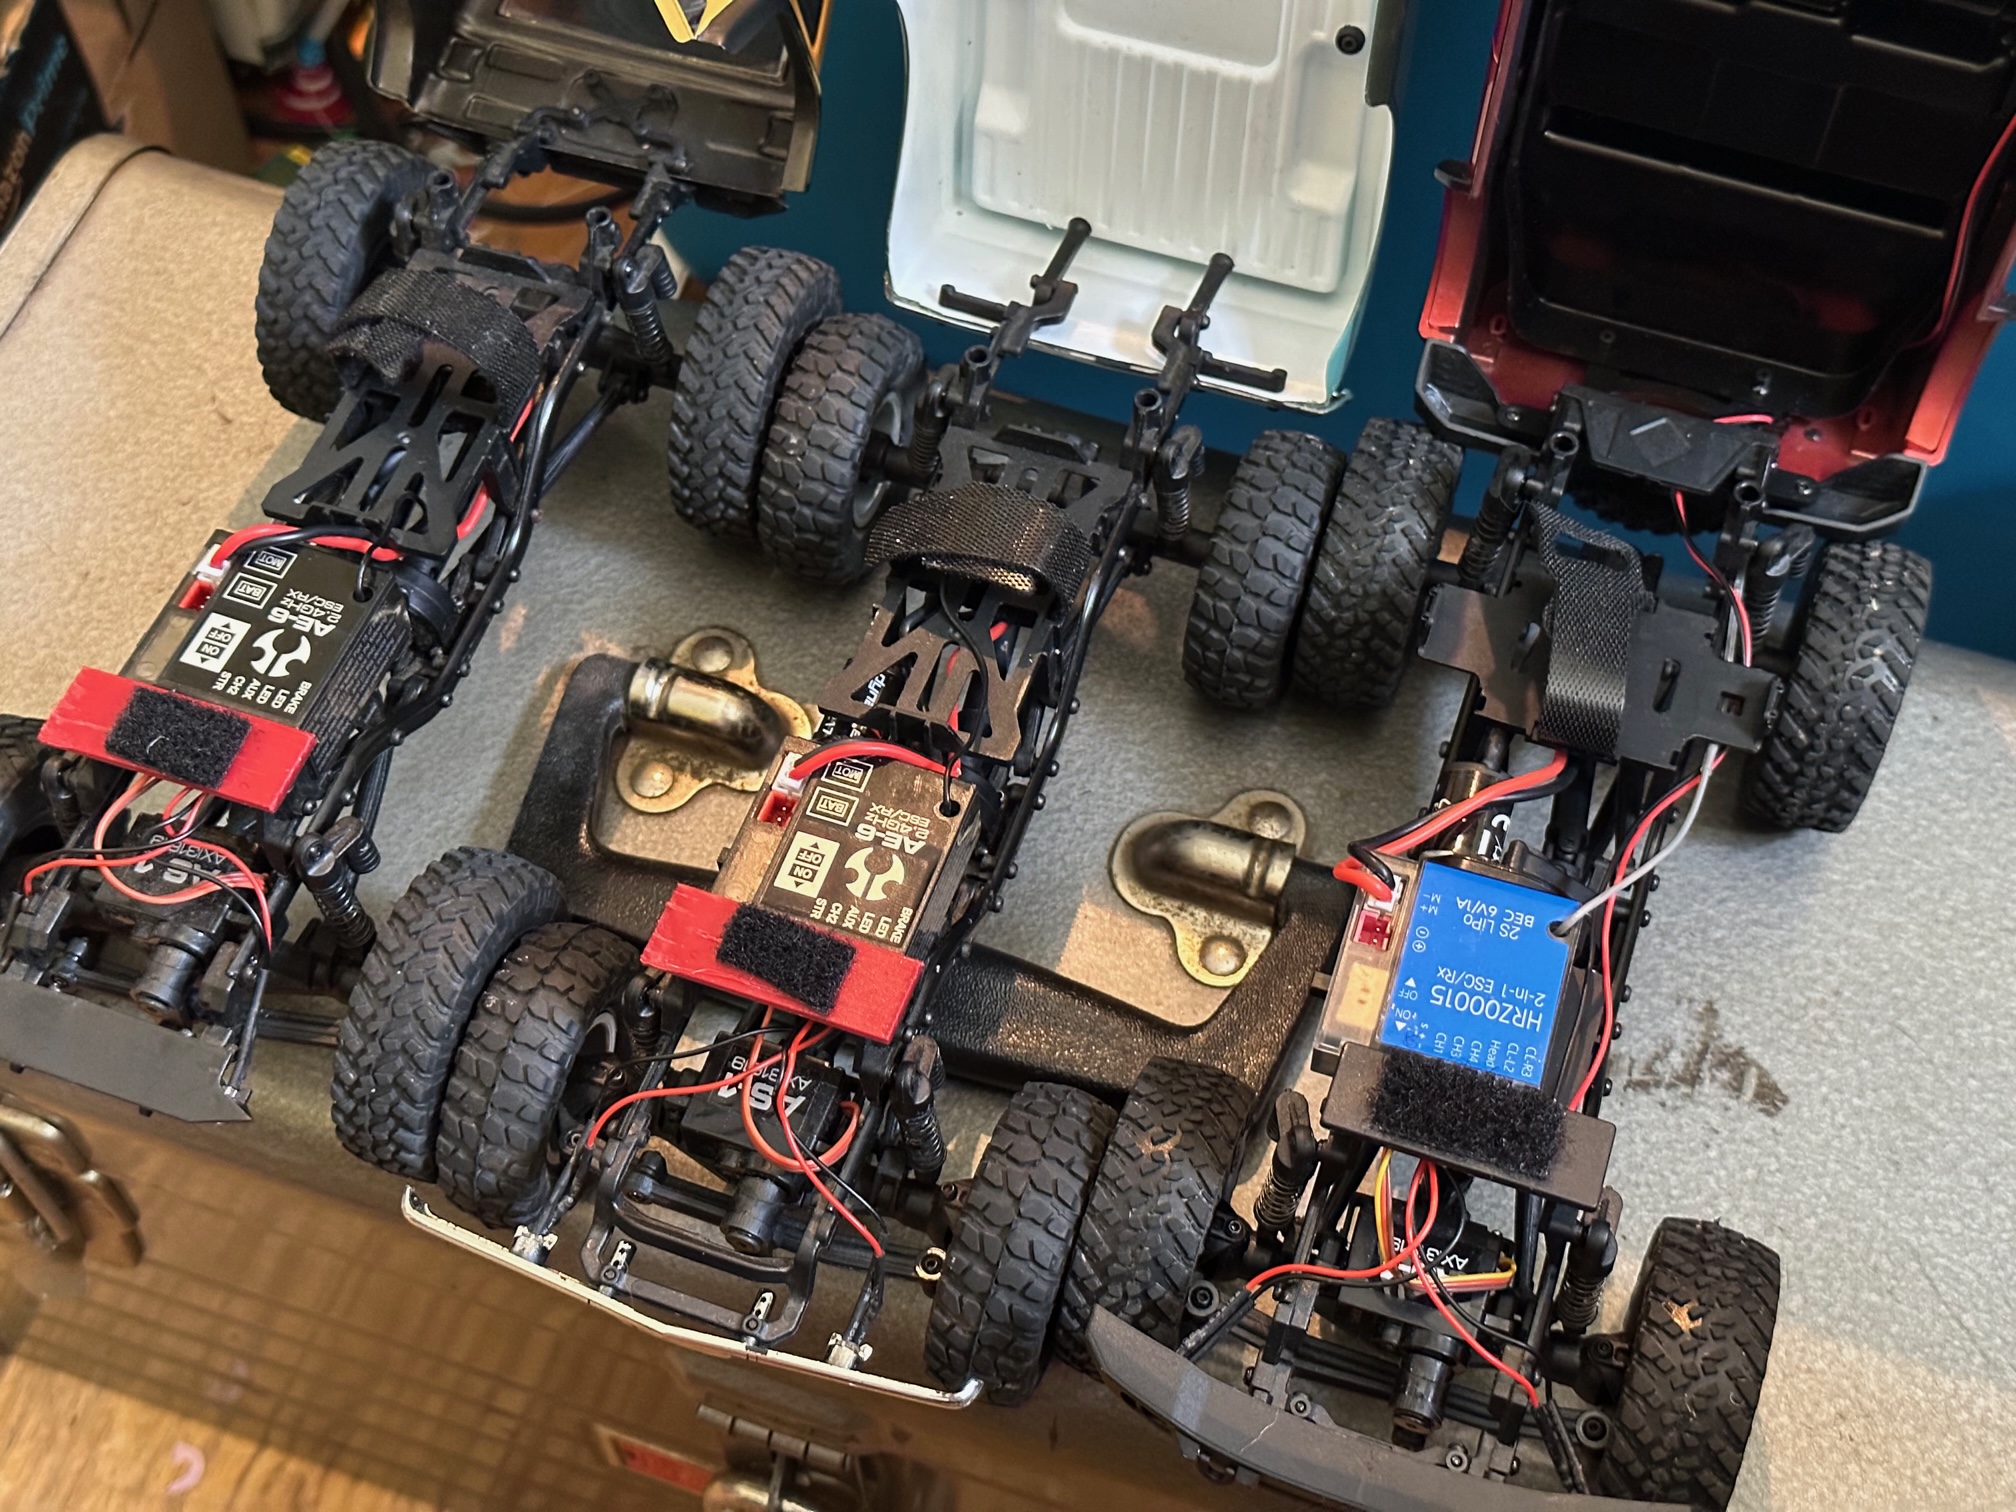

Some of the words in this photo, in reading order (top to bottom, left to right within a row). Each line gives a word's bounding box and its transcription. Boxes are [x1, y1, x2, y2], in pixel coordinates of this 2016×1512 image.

[258, 553, 284, 568] MOT
[238, 582, 263, 597] BAT
[286, 588, 344, 612] ESC/RX
[279, 596, 342, 624] 2.4GHz
[267, 606, 336, 637] AE-6
[208, 630, 232, 642] OFF
[201, 644, 221, 656] ON
[213, 671, 232, 691] STR
[227, 675, 246, 695] CH2
[241, 678, 261, 700] AUX
[256, 684, 274, 705] LED
[271, 689, 290, 709] LED
[284, 681, 312, 714] BRAKE
[835, 764, 861, 779] MOT
[820, 799, 845, 813] BAT
[869, 802, 931, 828] ESC/RX
[864, 811, 929, 839] 2.4GHz
[855, 823, 926, 853] AE-6
[798, 849, 822, 864] OFF
[793, 866, 813, 879] ON
[810, 897, 827, 919] STR
[825, 902, 843, 925] CH2
[841, 905, 859, 929] AUX
[1456, 896, 1497, 918] 6V/1A
[858, 912, 875, 934] LED
[874, 916, 891, 938] LED
[889, 906, 913, 943] BRAKE
[1463, 913, 1495, 934] LiPo
[1504, 909, 1534, 928] BEC
[1499, 923, 1521, 940] 2S
[1435, 966, 1494, 994] ESC/Rx
[1398, 988, 1418, 1000] OFF
[1501, 983, 1546, 1007] 2-in-1
[1429, 985, 1543, 1032] HRZ00015
[1433, 1032, 1447, 1053] CH1
[1450, 1035, 1465, 1058] CH3
[1469, 1040, 1483, 1063] CH4
[1485, 1039, 1501, 1068] Head
[1502, 1042, 1519, 1073] CL-L2
[1521, 1046, 1536, 1077] CL-R3
